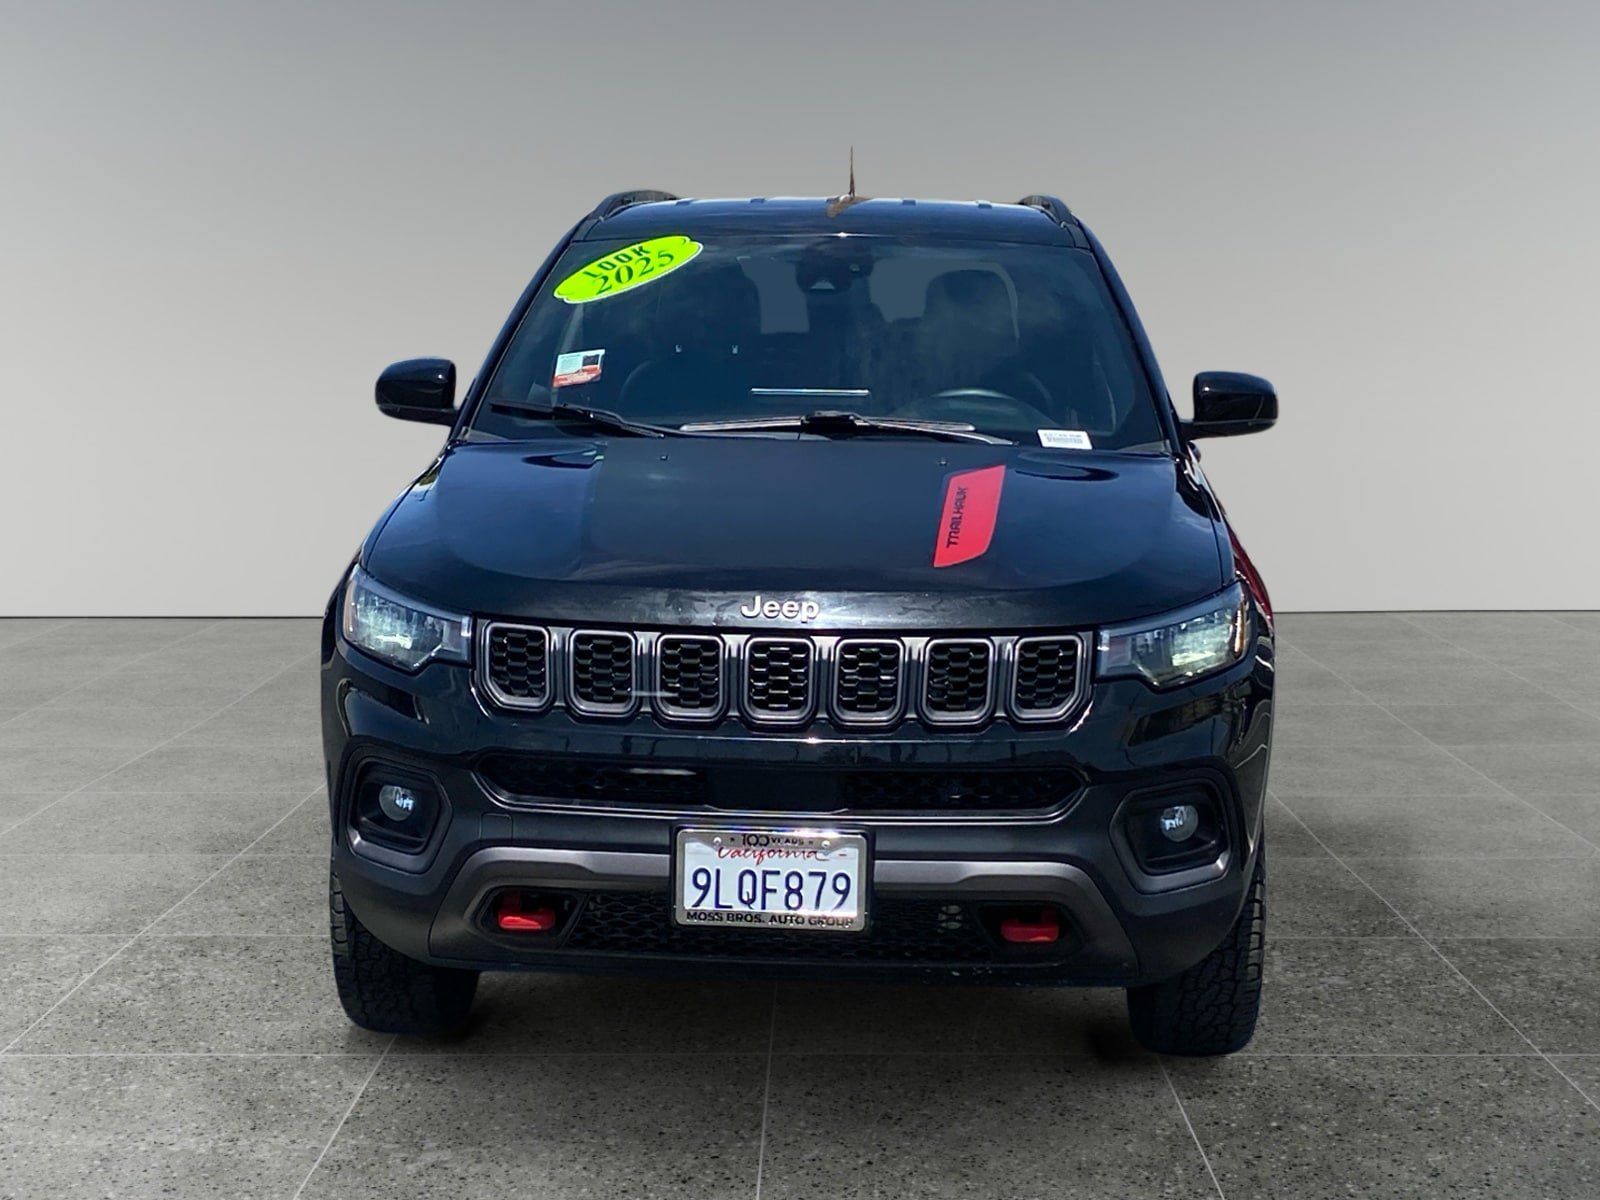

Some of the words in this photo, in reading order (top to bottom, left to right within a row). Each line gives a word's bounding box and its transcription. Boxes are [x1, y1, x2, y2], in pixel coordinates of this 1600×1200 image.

[583, 246, 650, 278] LOOK
[595, 249, 674, 295] 2025
[946, 486, 968, 549] TRAILHAWK
[740, 595, 819, 624] Jeep
[742, 834, 769, 846] 100
[718, 847, 830, 866] California
[691, 867, 852, 911] 9LQF879
[686, 911, 723, 922] MOSS
[726, 913, 765, 924] BROS.
[769, 915, 805, 926] AUTO
[808, 916, 855, 928] GROUP
